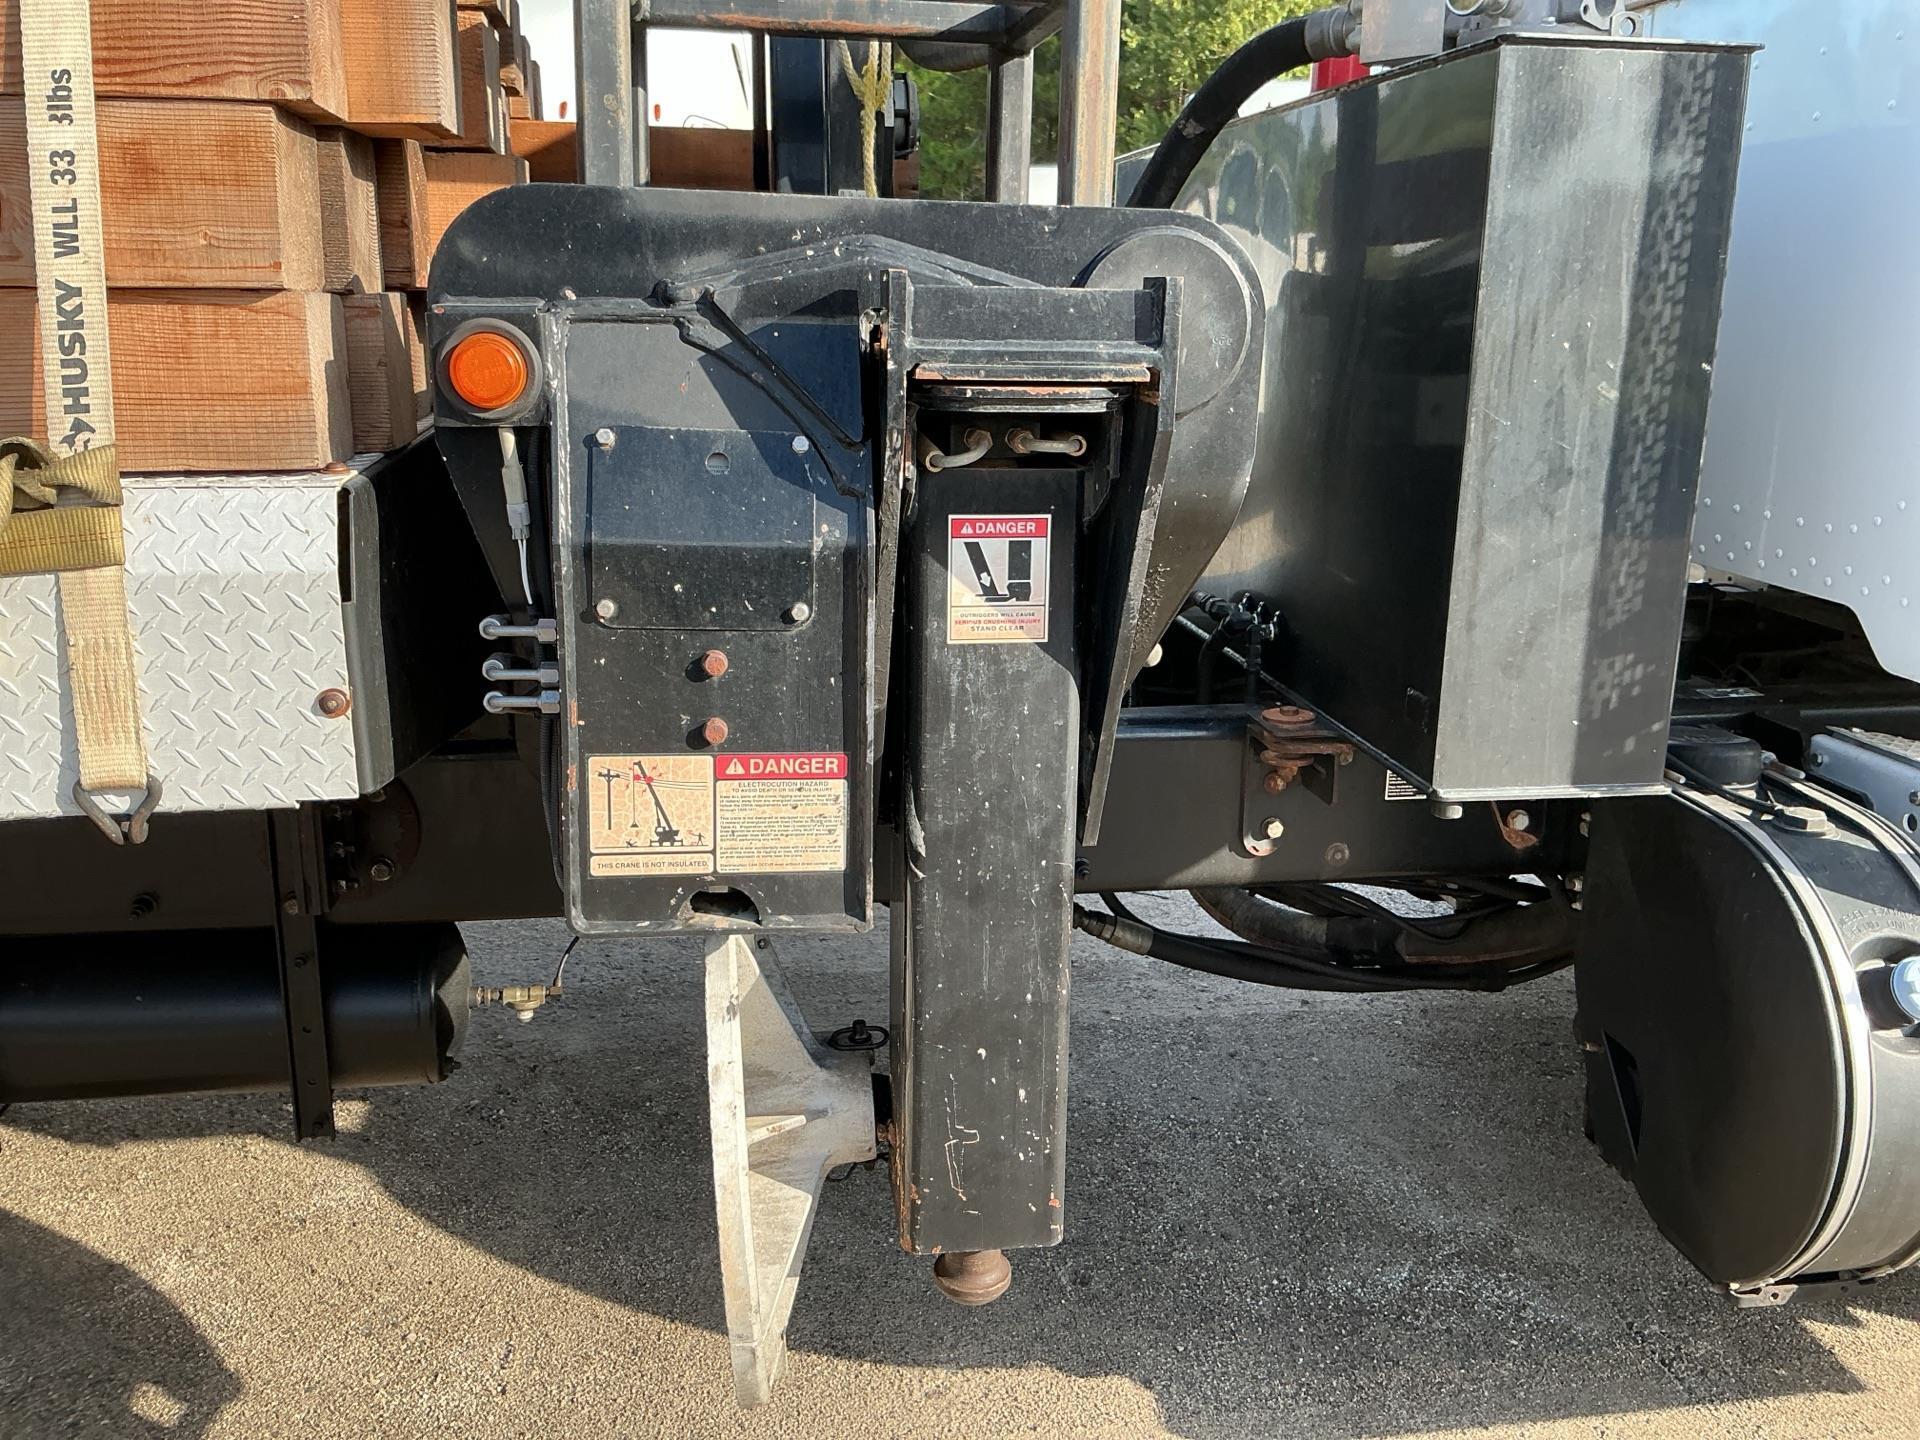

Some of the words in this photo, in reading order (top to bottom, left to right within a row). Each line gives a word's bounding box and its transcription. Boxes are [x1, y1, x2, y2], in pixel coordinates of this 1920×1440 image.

[50, 149, 77, 186] 33
[52, 197, 80, 260] WLL
[54, 277, 91, 415] HUSKY
[975, 522, 1036, 534] DANGER
[749, 757, 839, 775] DANGER
[667, 860, 709, 868] INSULATED.
